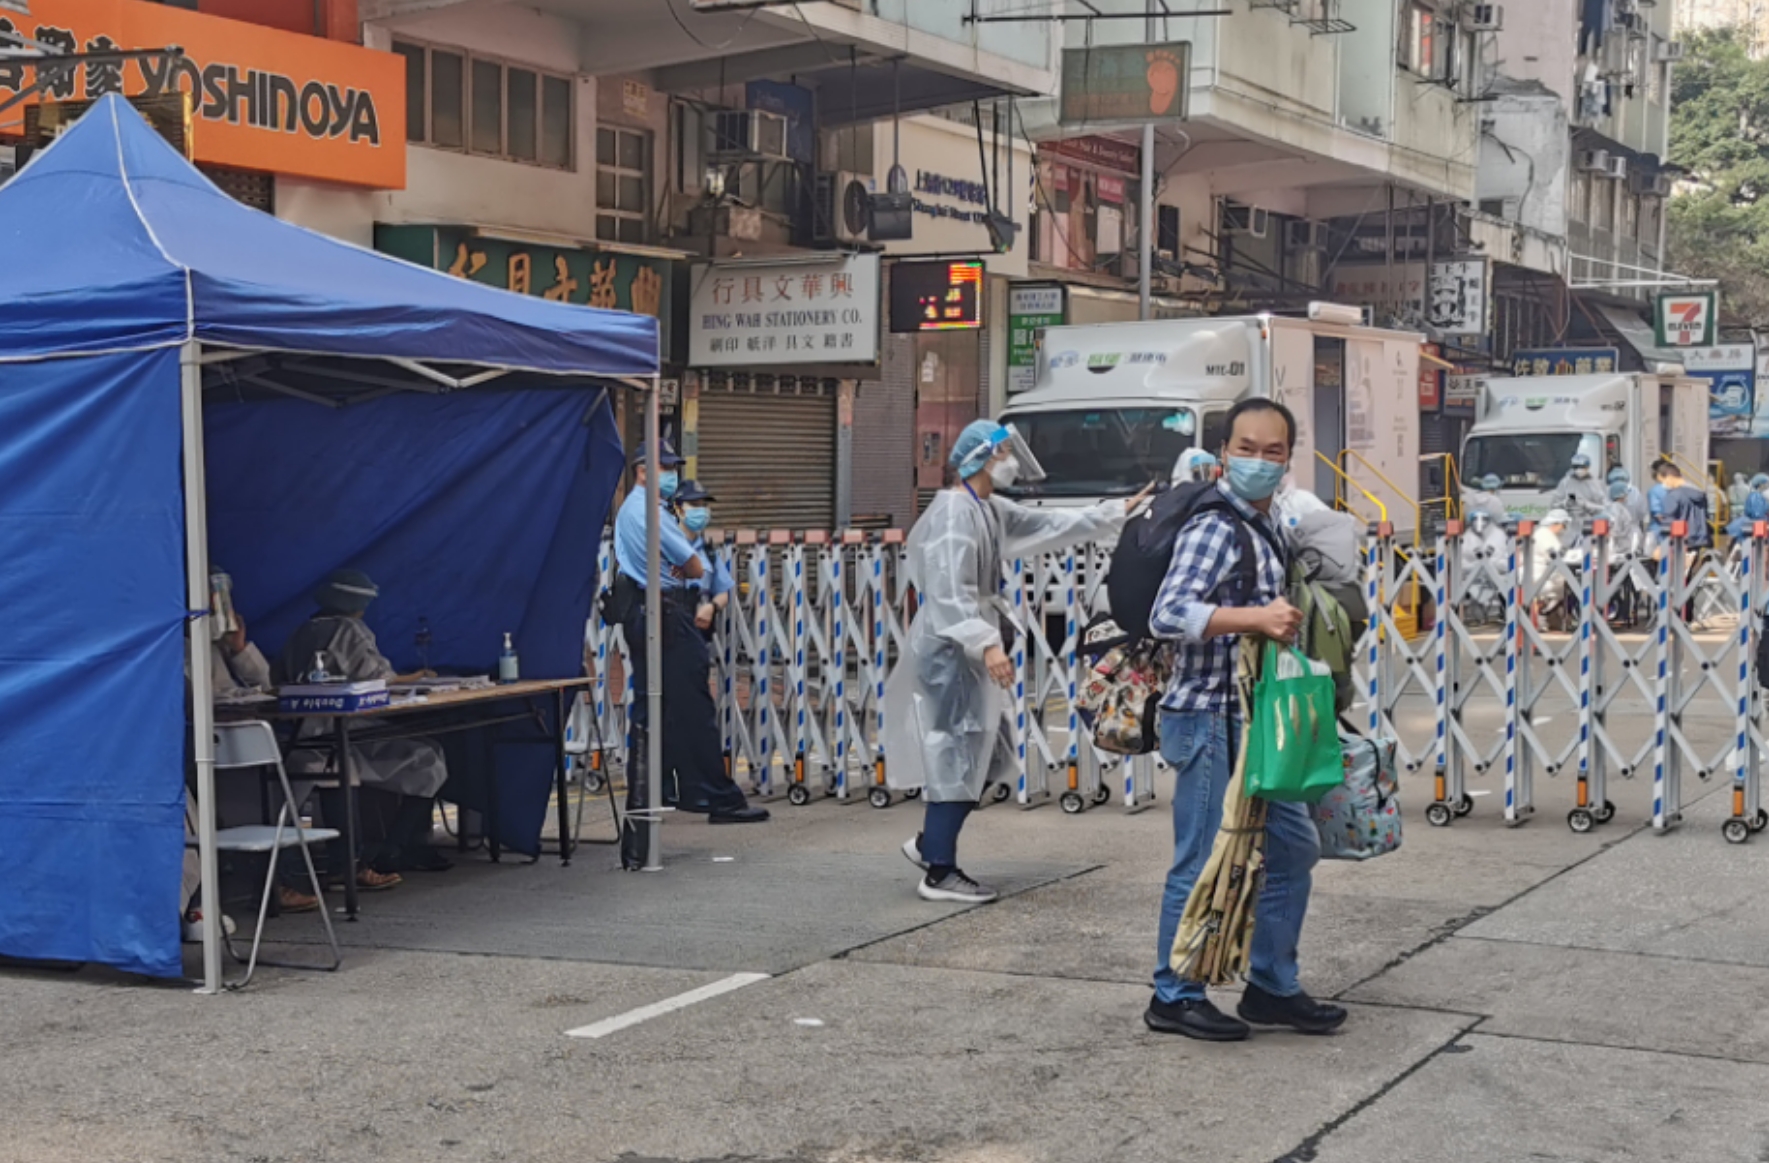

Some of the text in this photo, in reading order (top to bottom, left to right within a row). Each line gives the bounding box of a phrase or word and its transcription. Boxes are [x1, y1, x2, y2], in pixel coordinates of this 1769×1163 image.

[134, 47, 381, 147] YOSHINOYA
[735, 312, 762, 328] WAH
[765, 309, 837, 328] STATIONERY
[842, 308, 863, 324] CO.
[1670, 303, 1702, 344] 7
